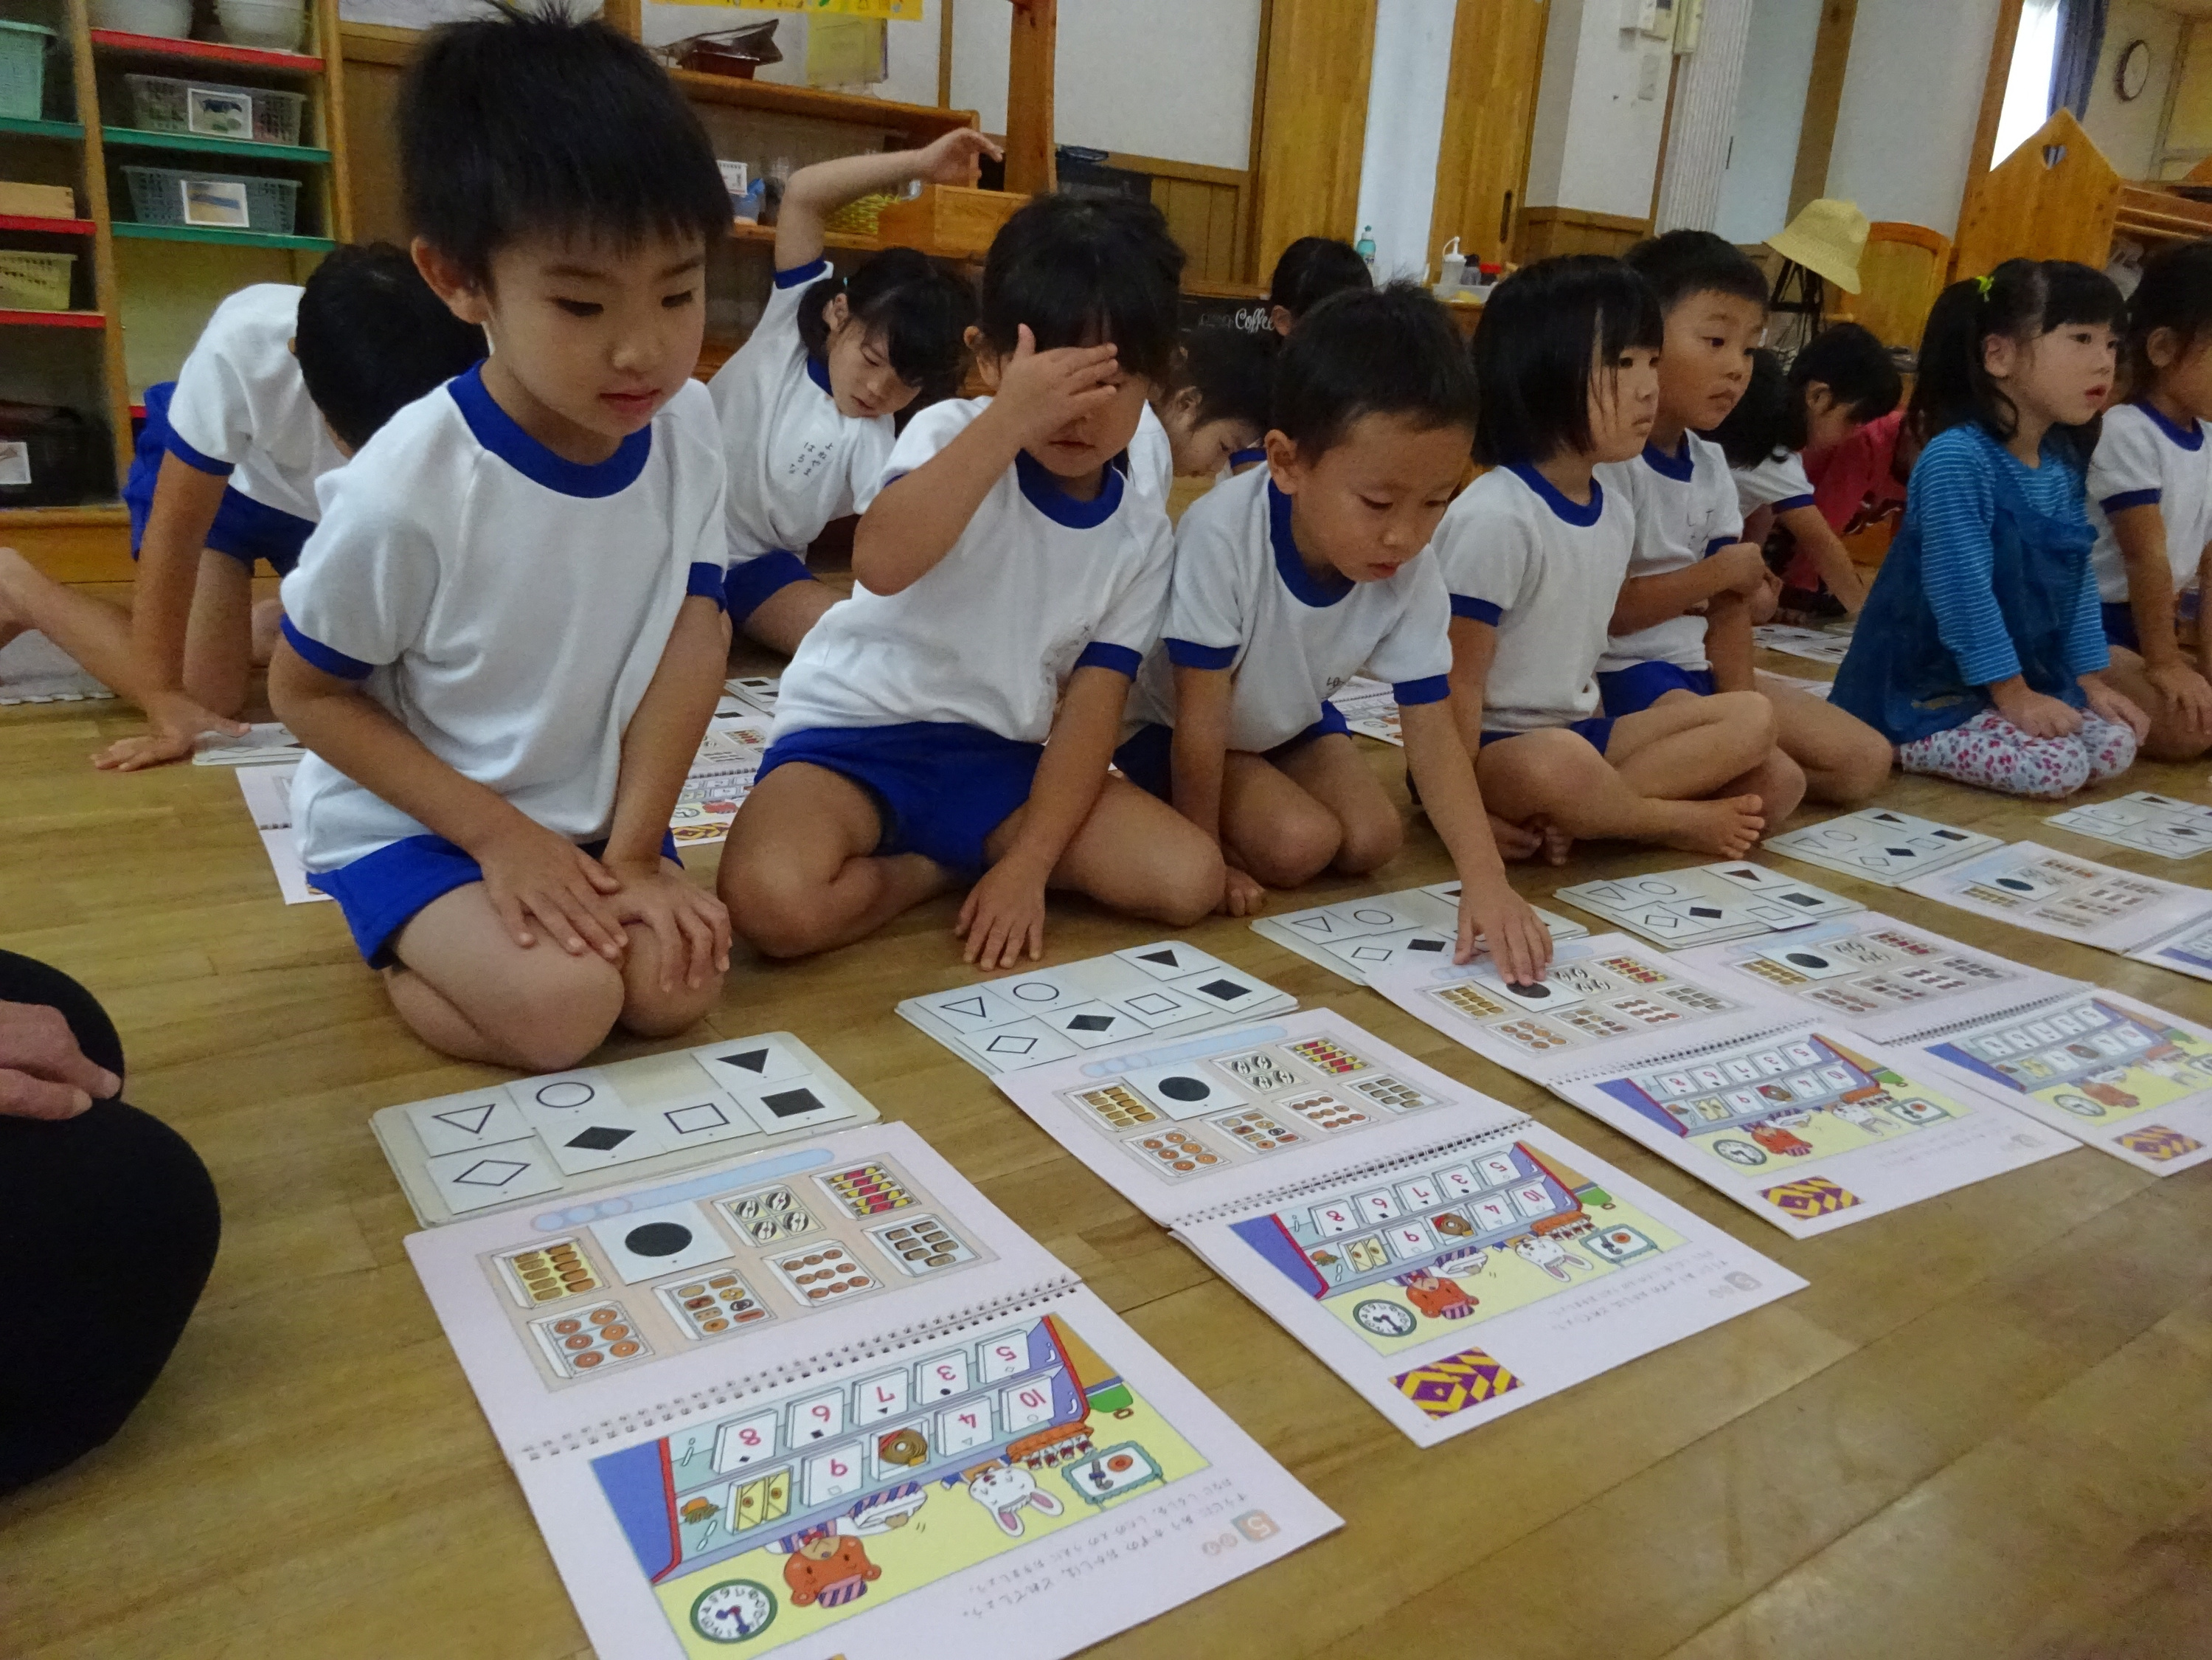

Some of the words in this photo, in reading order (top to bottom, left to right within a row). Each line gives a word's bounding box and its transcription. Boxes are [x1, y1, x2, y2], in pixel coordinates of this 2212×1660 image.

[1489, 1161, 1508, 1172] 5
[1450, 1174, 1469, 1185] 3
[1412, 1186, 1430, 1198] 7
[1522, 1189, 1546, 1202] 10
[1371, 1197, 1387, 1208] 6
[1484, 1204, 1500, 1214] 4
[1325, 1210, 1345, 1222] 8
[1403, 1231, 1420, 1242] 9
[996, 1346, 1017, 1361] 5
[937, 1365, 957, 1380] 3
[876, 1386, 896, 1403] 7
[1019, 1388, 1047, 1408] 10
[811, 1405, 831, 1422] 6
[958, 1413, 977, 1428] 4
[738, 1428, 762, 1446] 8
[830, 1458, 848, 1477] 9
[1247, 1515, 1272, 1538] 5
